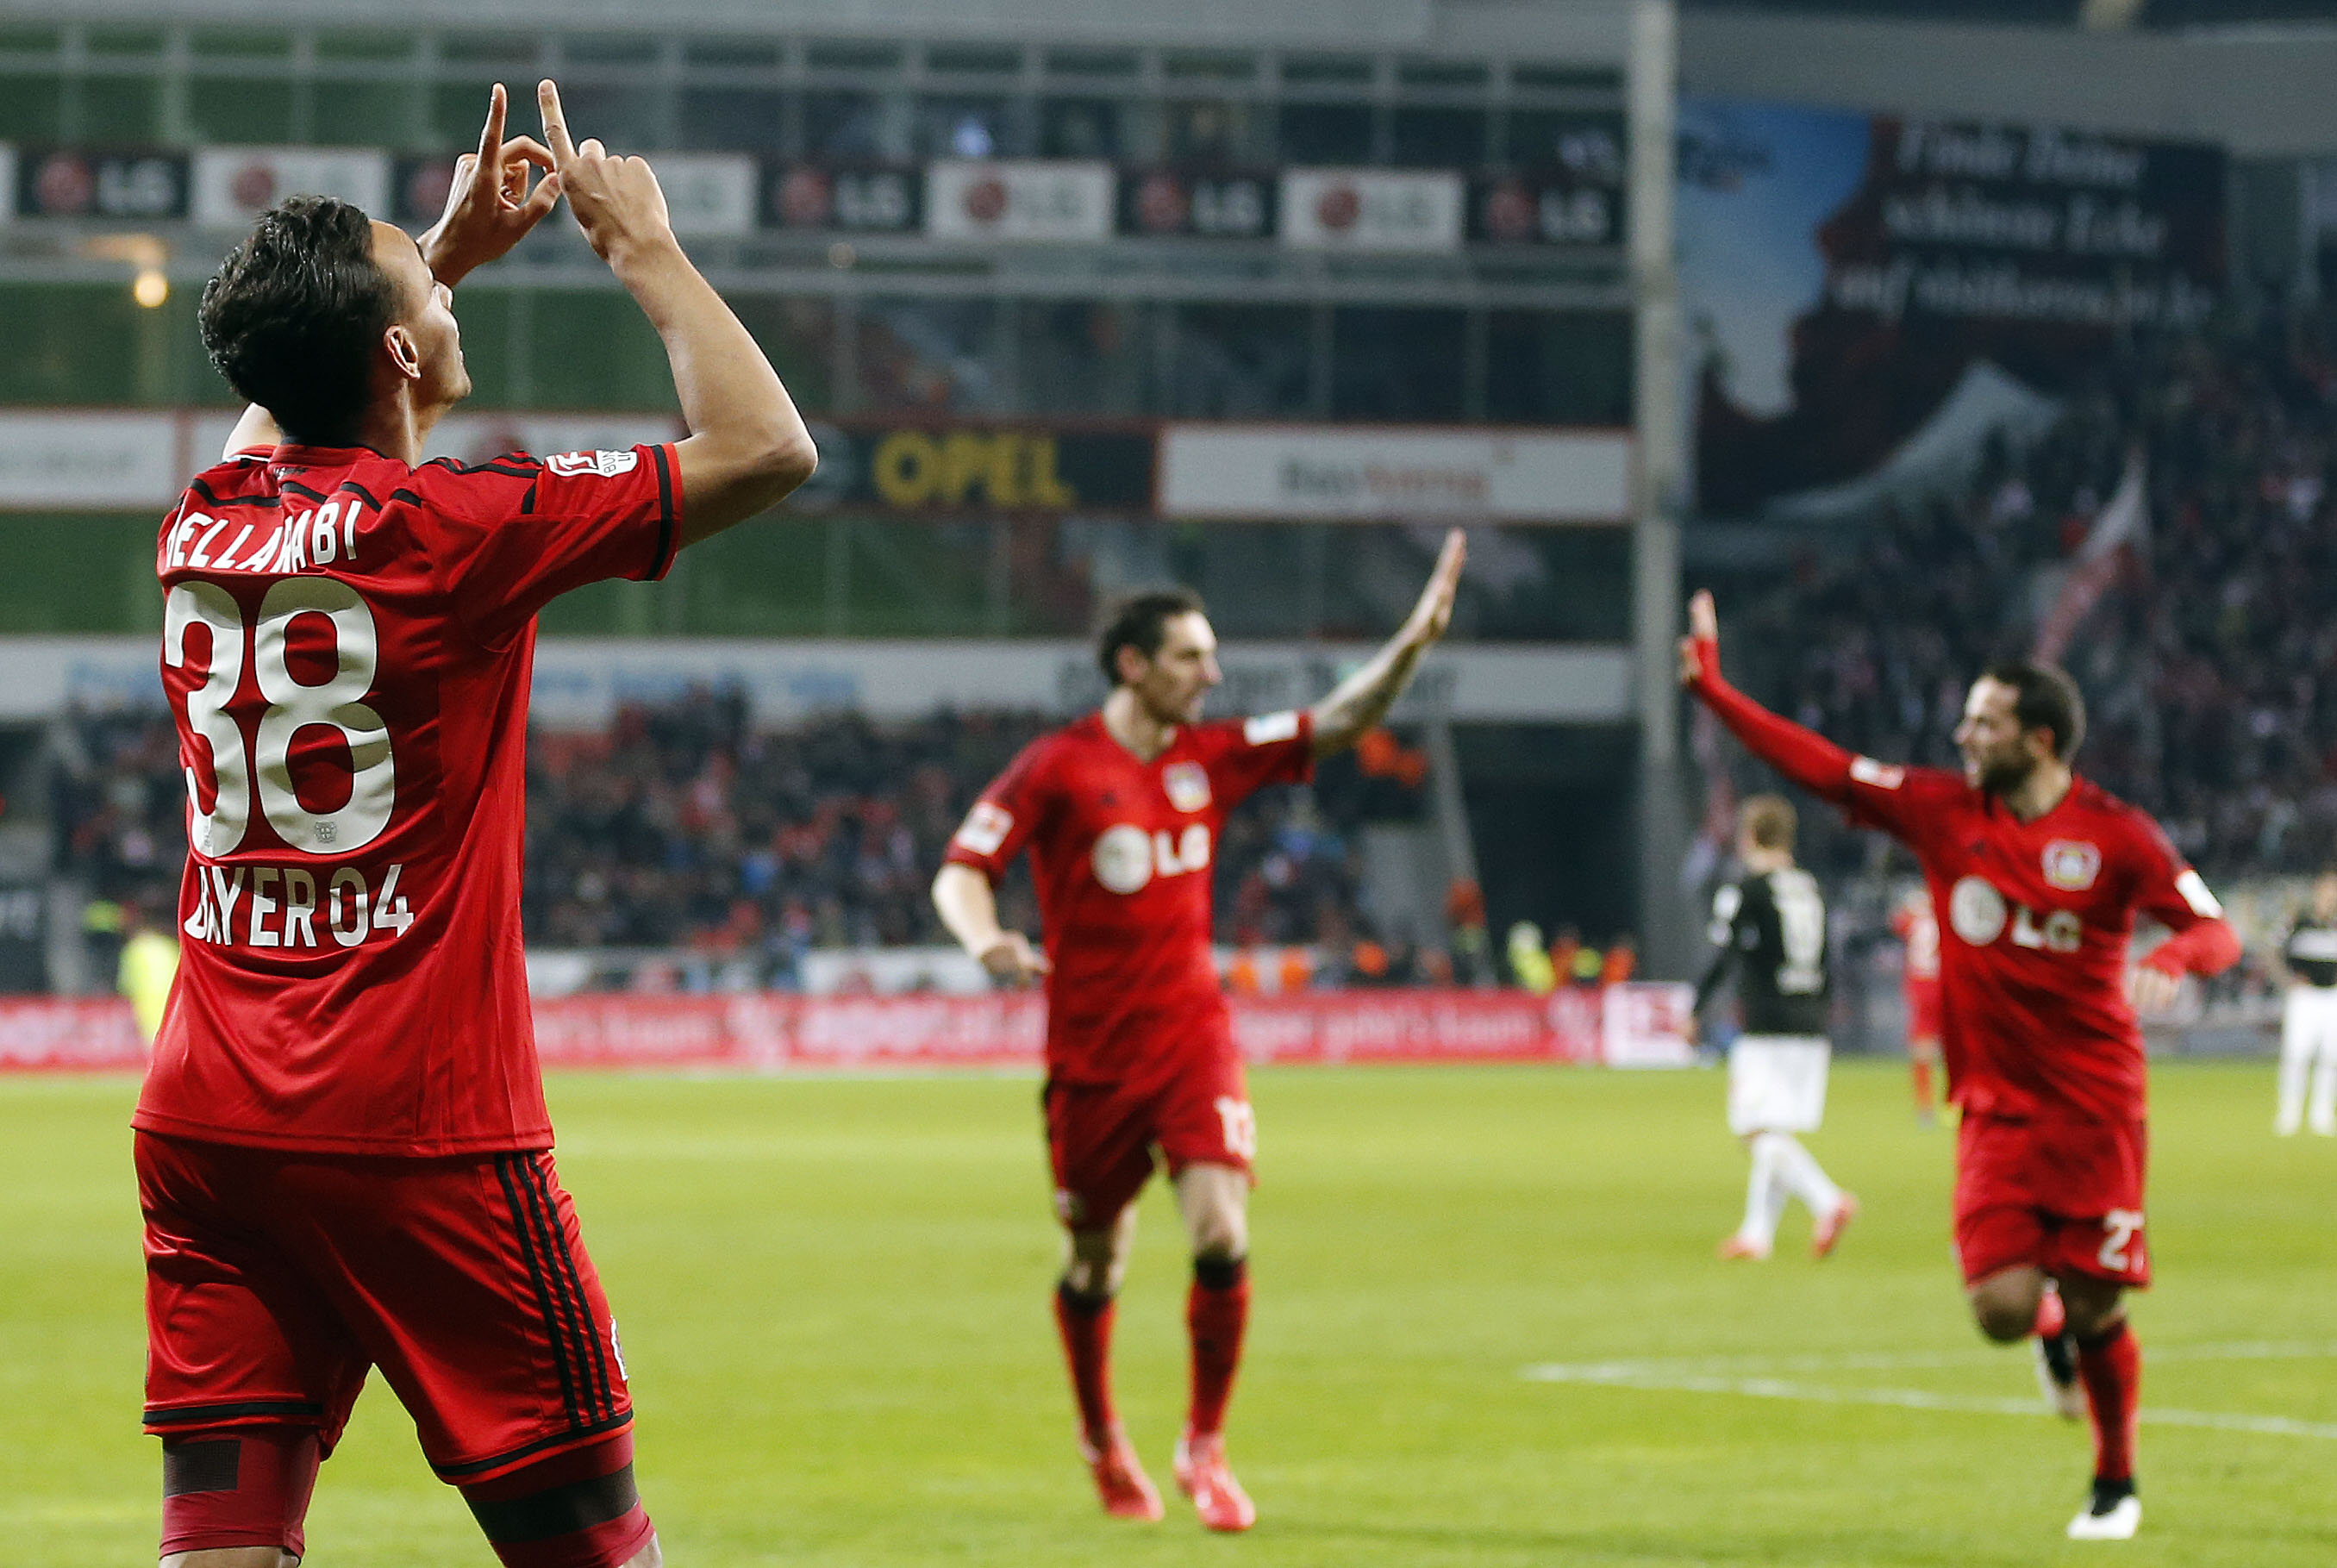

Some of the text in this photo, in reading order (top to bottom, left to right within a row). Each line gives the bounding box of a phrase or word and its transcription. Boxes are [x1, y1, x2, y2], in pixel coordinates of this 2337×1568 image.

[872, 431, 1074, 505] OPEL
[165, 579, 396, 858] 38
[1155, 823, 1210, 878] LG
[329, 864, 415, 947] 04
[2011, 905, 2082, 953] LG
